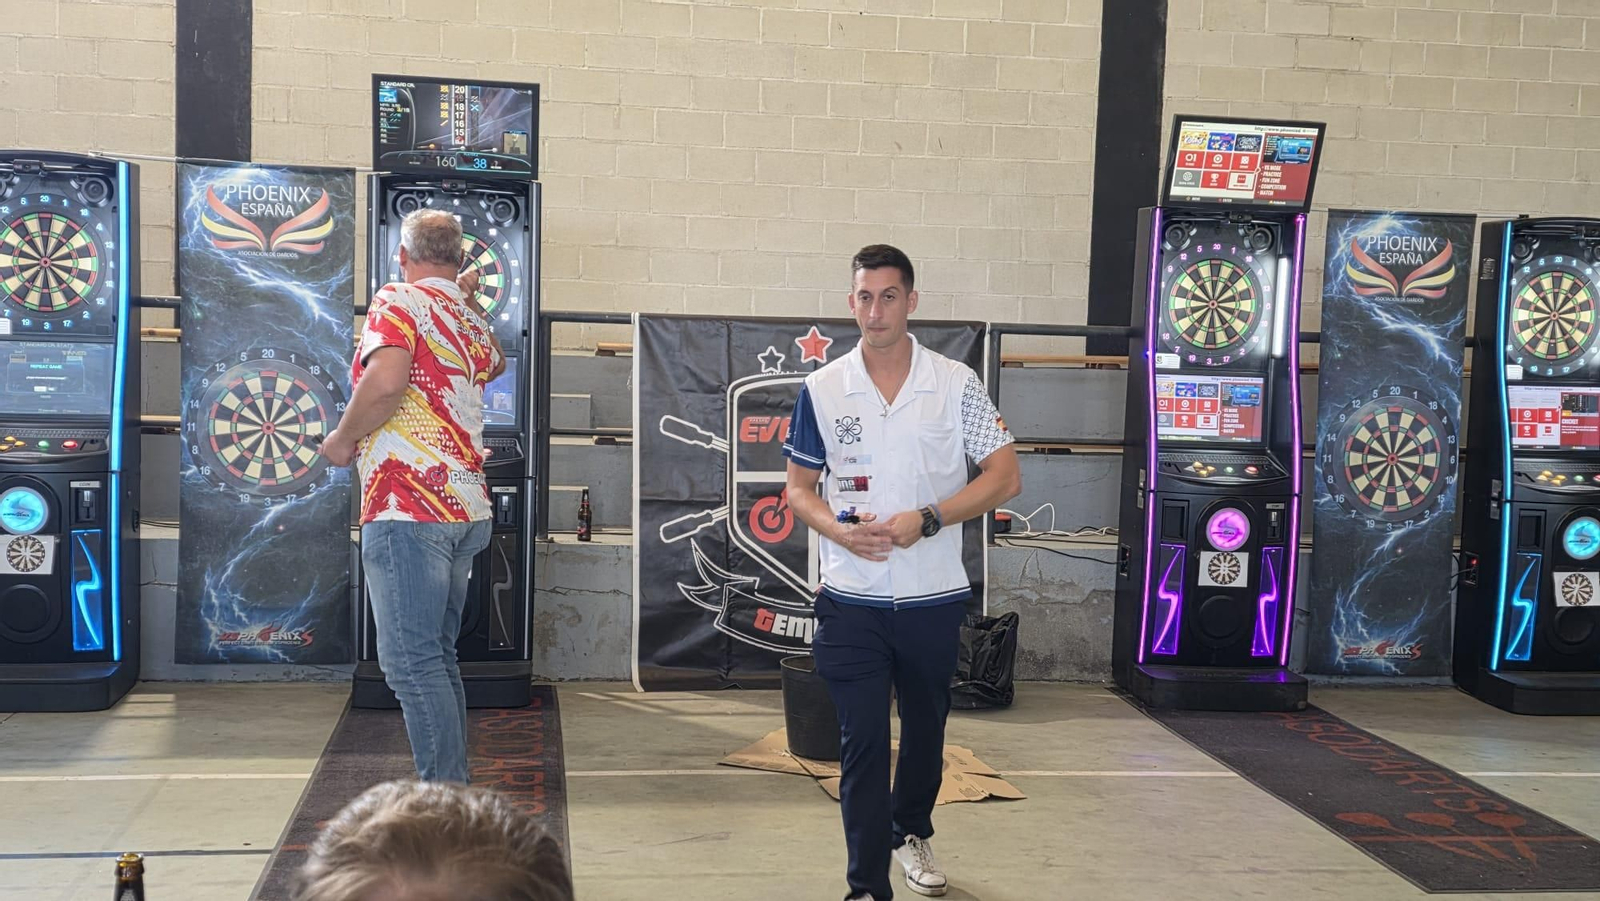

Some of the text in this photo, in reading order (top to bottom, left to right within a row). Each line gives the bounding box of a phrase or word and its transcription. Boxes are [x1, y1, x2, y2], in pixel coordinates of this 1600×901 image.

[436, 156, 456, 167] 160
[473, 158, 487, 169] 38
[226, 185, 312, 204] PHOENIX
[241, 202, 296, 217] ESPAÑA
[1368, 236, 1438, 252] PHOENIX
[1379, 252, 1424, 265] ESPAÑA
[262, 349, 274, 359] 20
[290, 354, 295, 362] 1
[215, 363, 226, 372] 12
[309, 365, 320, 374] 18
[202, 379, 209, 387] 9
[327, 382, 334, 390] 4
[1390, 387, 1400, 395] 20
[1413, 391, 1418, 399] 1
[191, 400, 199, 408] 14
[335, 403, 345, 411] 13
[187, 423, 195, 431] 11
[200, 466, 210, 475] 16
[325, 467, 335, 475] 15
[218, 483, 225, 491] 7
[239, 494, 250, 502] 19
[264, 497, 271, 506] 3
[286, 494, 296, 503] 17
[1424, 510, 1430, 518] 2
[754, 607, 818, 644] GEM
